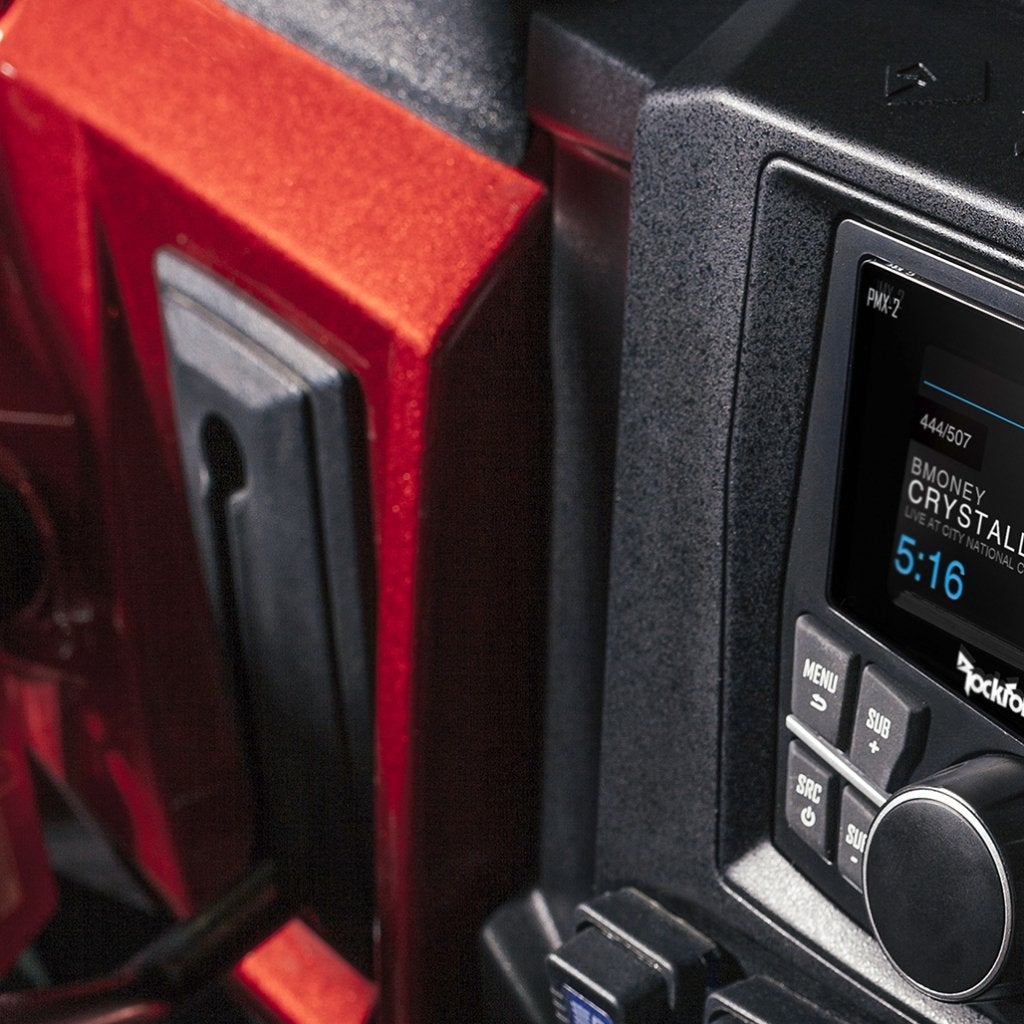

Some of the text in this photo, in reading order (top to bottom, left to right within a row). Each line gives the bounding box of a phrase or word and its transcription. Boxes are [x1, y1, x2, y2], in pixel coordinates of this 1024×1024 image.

[866, 287, 899, 319] PMX-2
[919, 413, 973, 449] 444/507
[910, 456, 987, 506] BMONEY
[904, 505, 927, 526] LIVE
[927, 516, 942, 533] AT
[942, 523, 966, 544] CITY
[966, 536, 1015, 571] NATIONAL
[893, 533, 967, 601] 5:16
[803, 658, 839, 694] MENU
[866, 707, 892, 739] SUB
[795, 773, 823, 804] SRC
